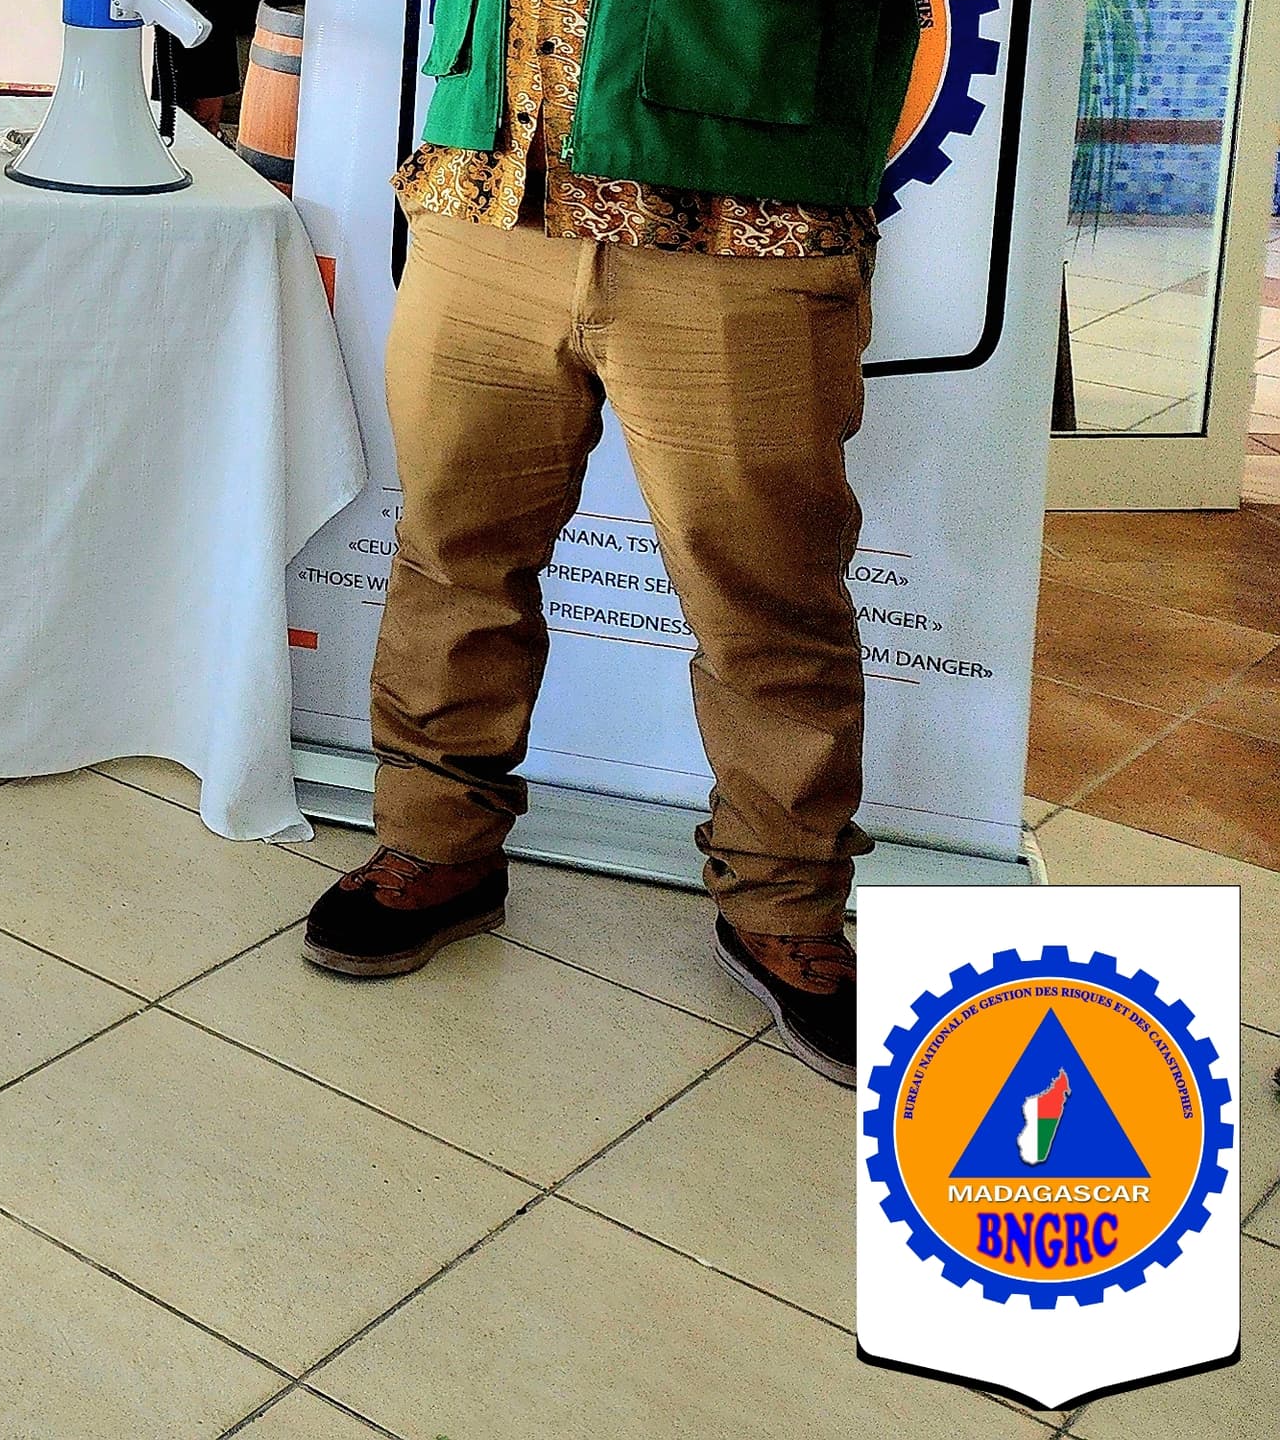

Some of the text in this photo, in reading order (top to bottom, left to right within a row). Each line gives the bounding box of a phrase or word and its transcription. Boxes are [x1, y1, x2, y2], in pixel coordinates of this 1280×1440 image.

[547, 564, 639, 590] PREPARER
[549, 601, 692, 636] PREPAREDNESS
[856, 606, 928, 631] ANGER
